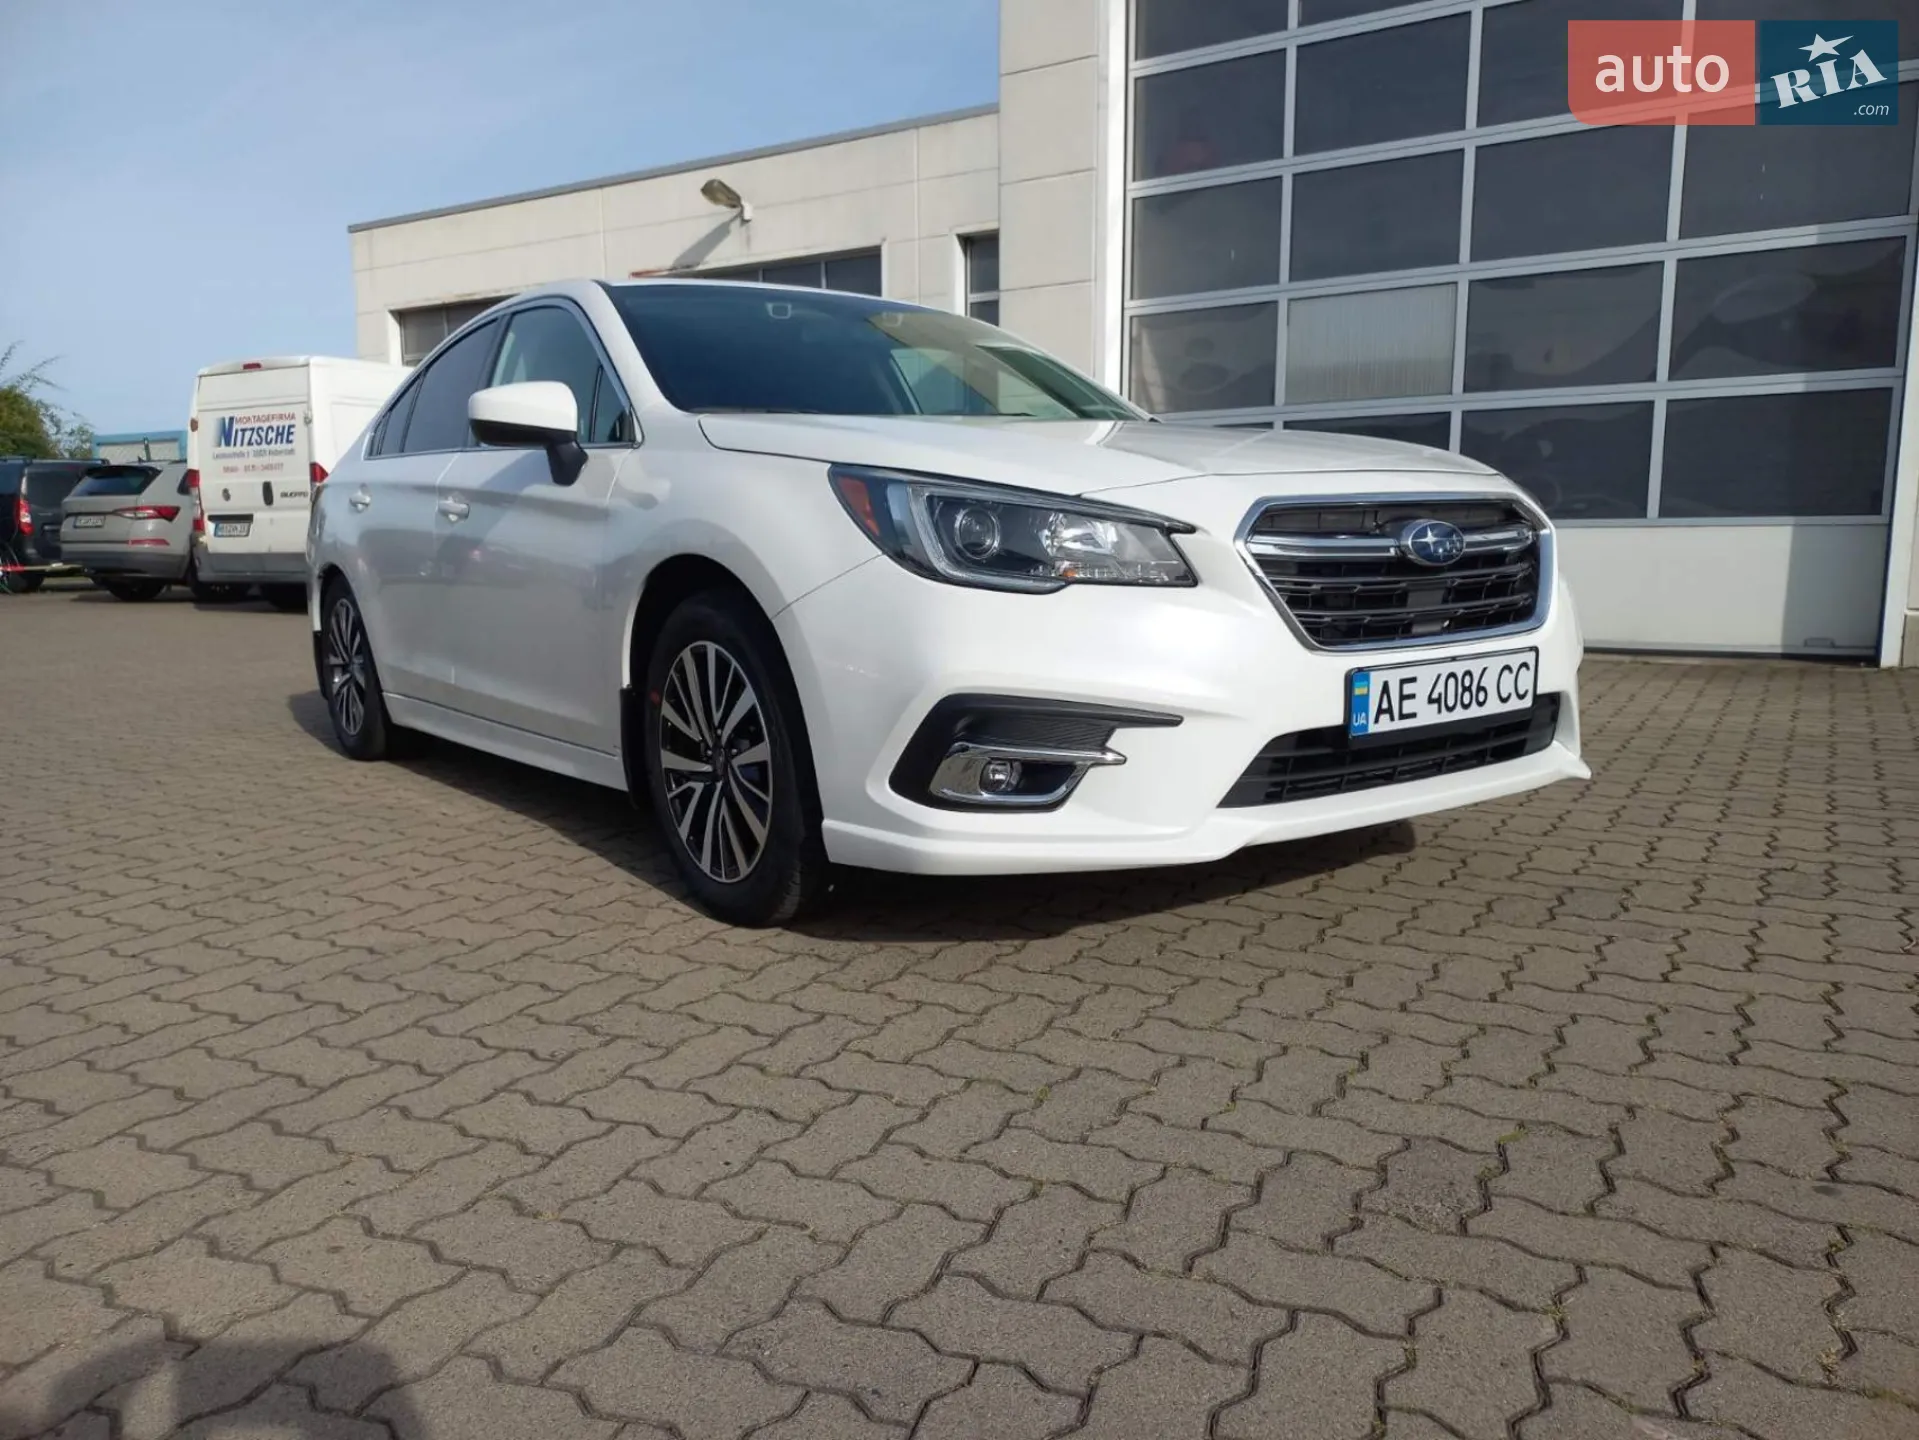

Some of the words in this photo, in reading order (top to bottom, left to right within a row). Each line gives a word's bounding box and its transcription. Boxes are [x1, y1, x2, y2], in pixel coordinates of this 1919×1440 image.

[235, 412, 296, 424] MONTAGEFIRMA
[215, 416, 296, 447] NITZSCHE
[1373, 676, 1418, 724] AE
[1427, 666, 1488, 714] 4086
[1496, 661, 1530, 703] CC
[1352, 712, 1367, 725] UA
